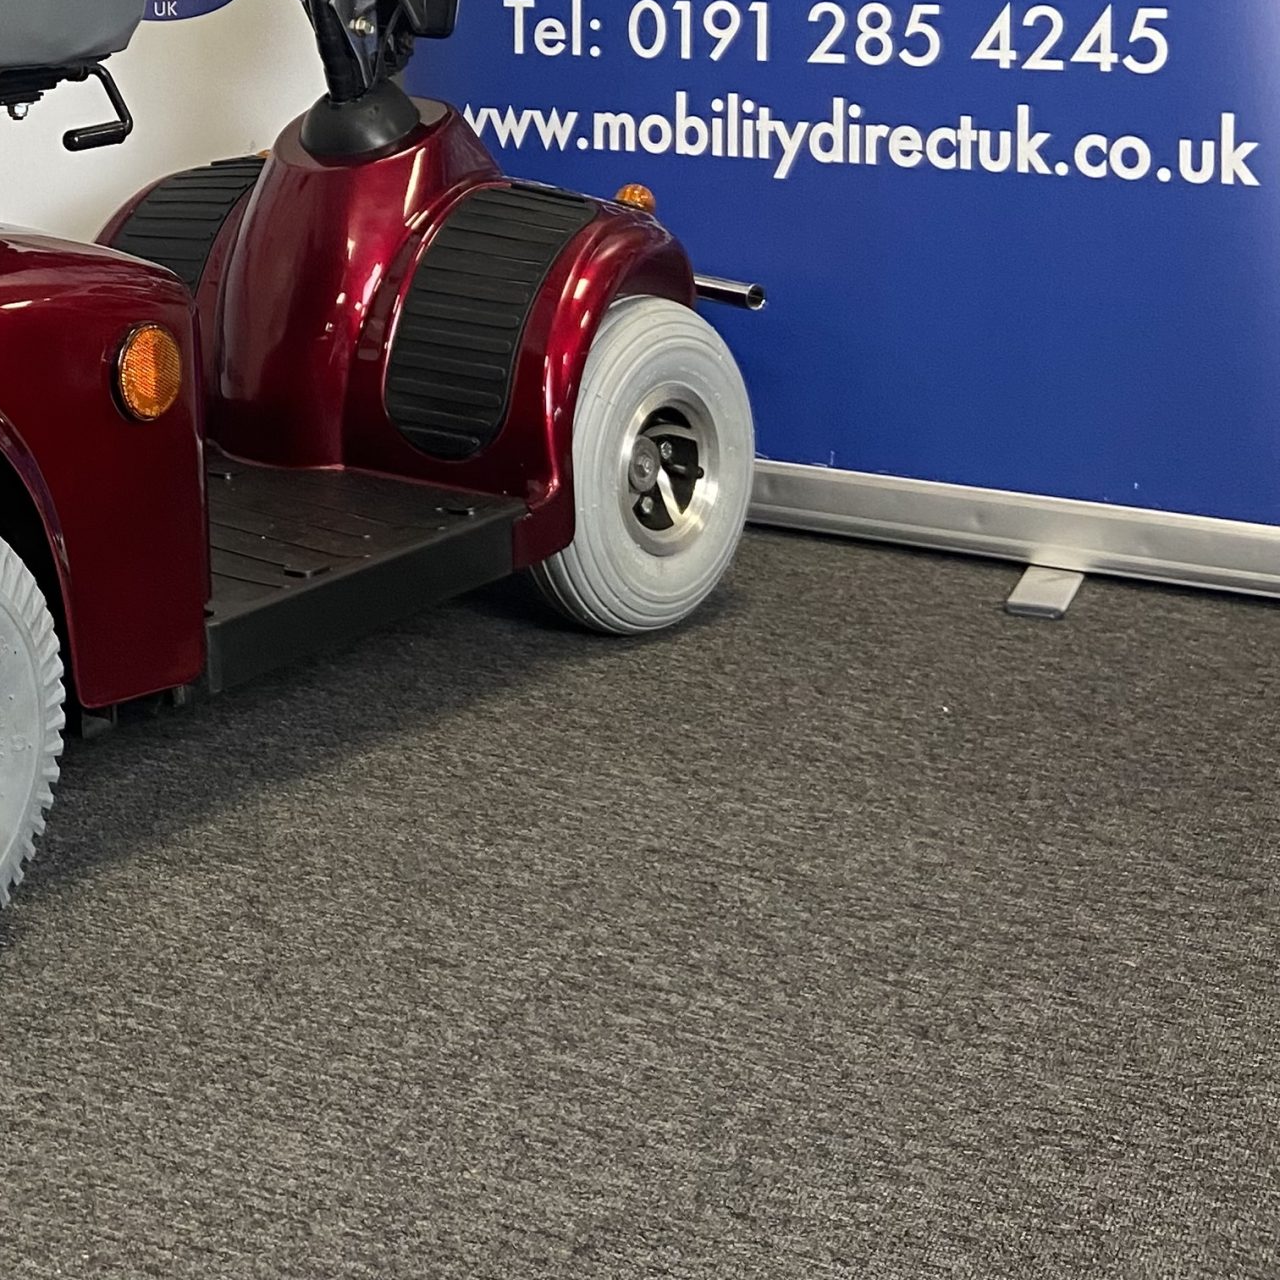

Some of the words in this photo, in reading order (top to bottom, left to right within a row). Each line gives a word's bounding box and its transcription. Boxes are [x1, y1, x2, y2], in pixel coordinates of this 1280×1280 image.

[153, 0, 178, 17] UK
[807, 1, 942, 68] 285
[970, 2, 1170, 75] 4245
[462, 90, 1261, 187] www.mobilitydirectuk.co.uk
